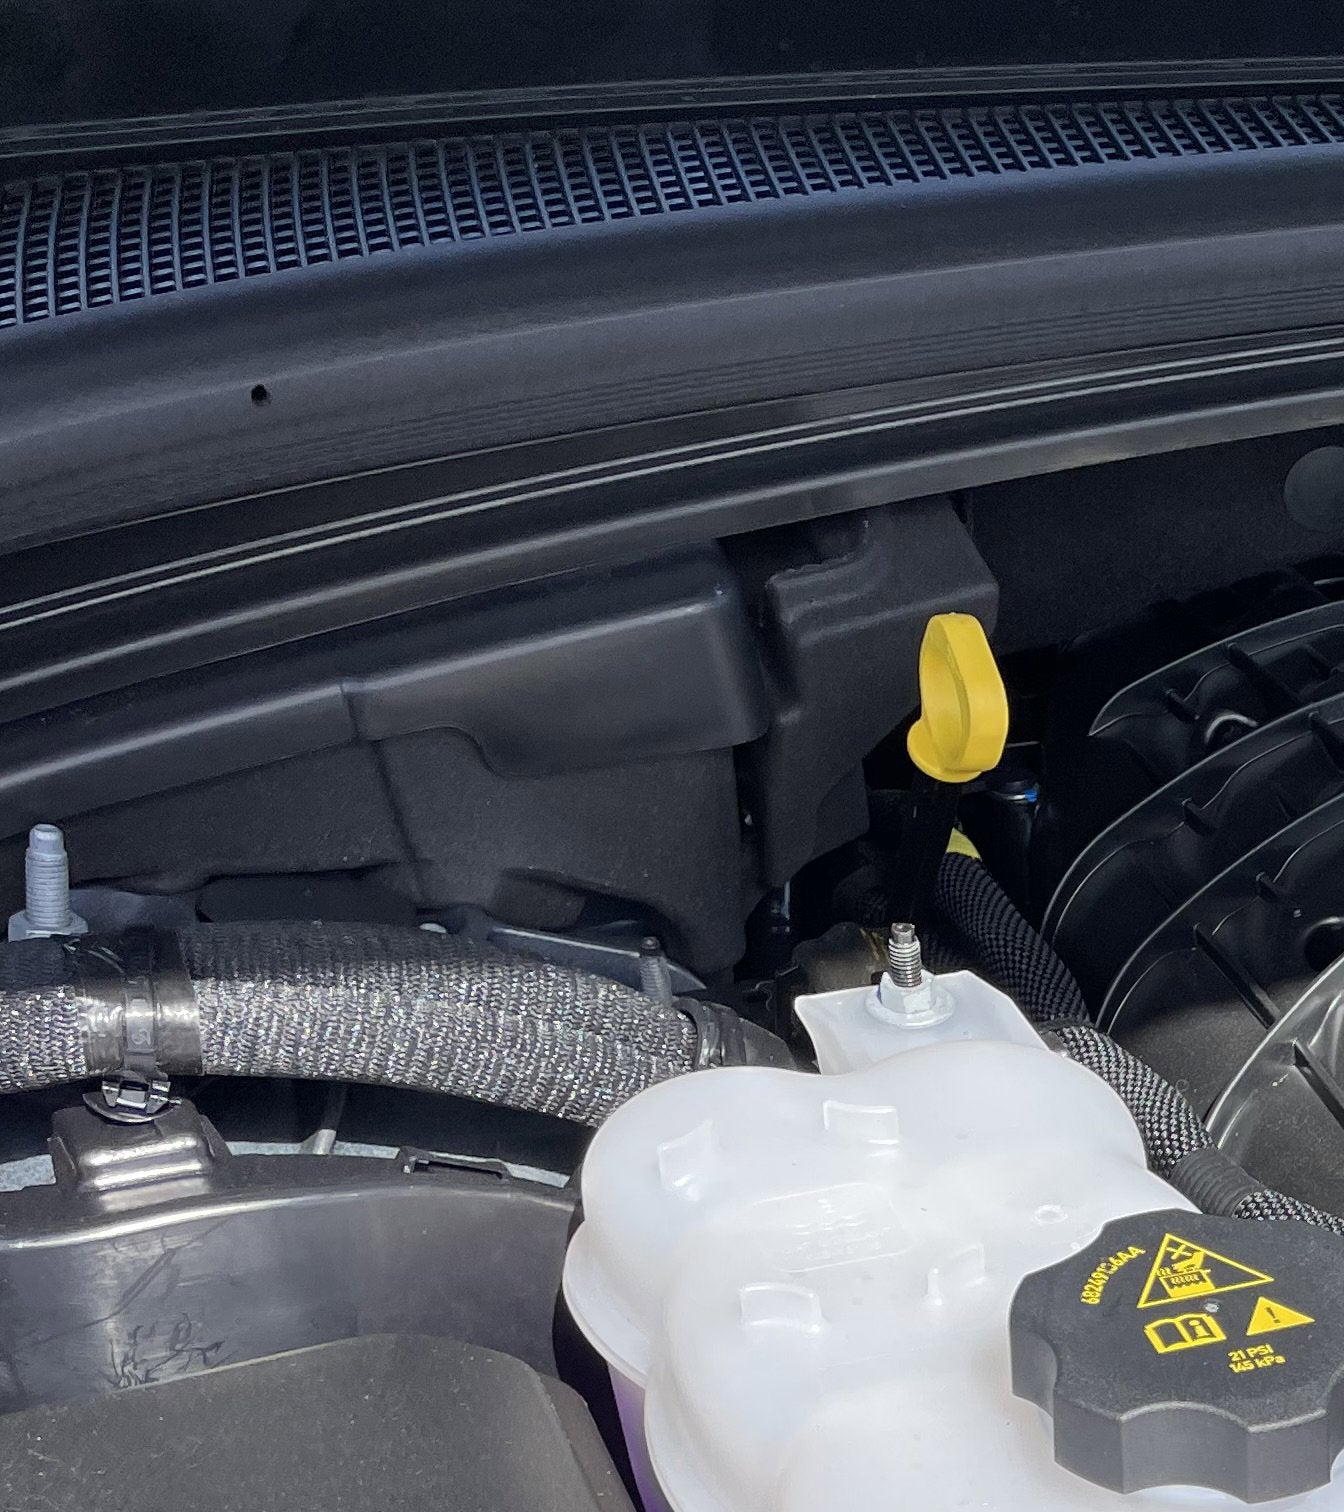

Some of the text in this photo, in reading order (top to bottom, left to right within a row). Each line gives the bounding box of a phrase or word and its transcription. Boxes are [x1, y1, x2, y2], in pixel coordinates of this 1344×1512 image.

[1228, 1343, 1274, 1362] 21 PSI
[1254, 1355, 1286, 1368] kPa
